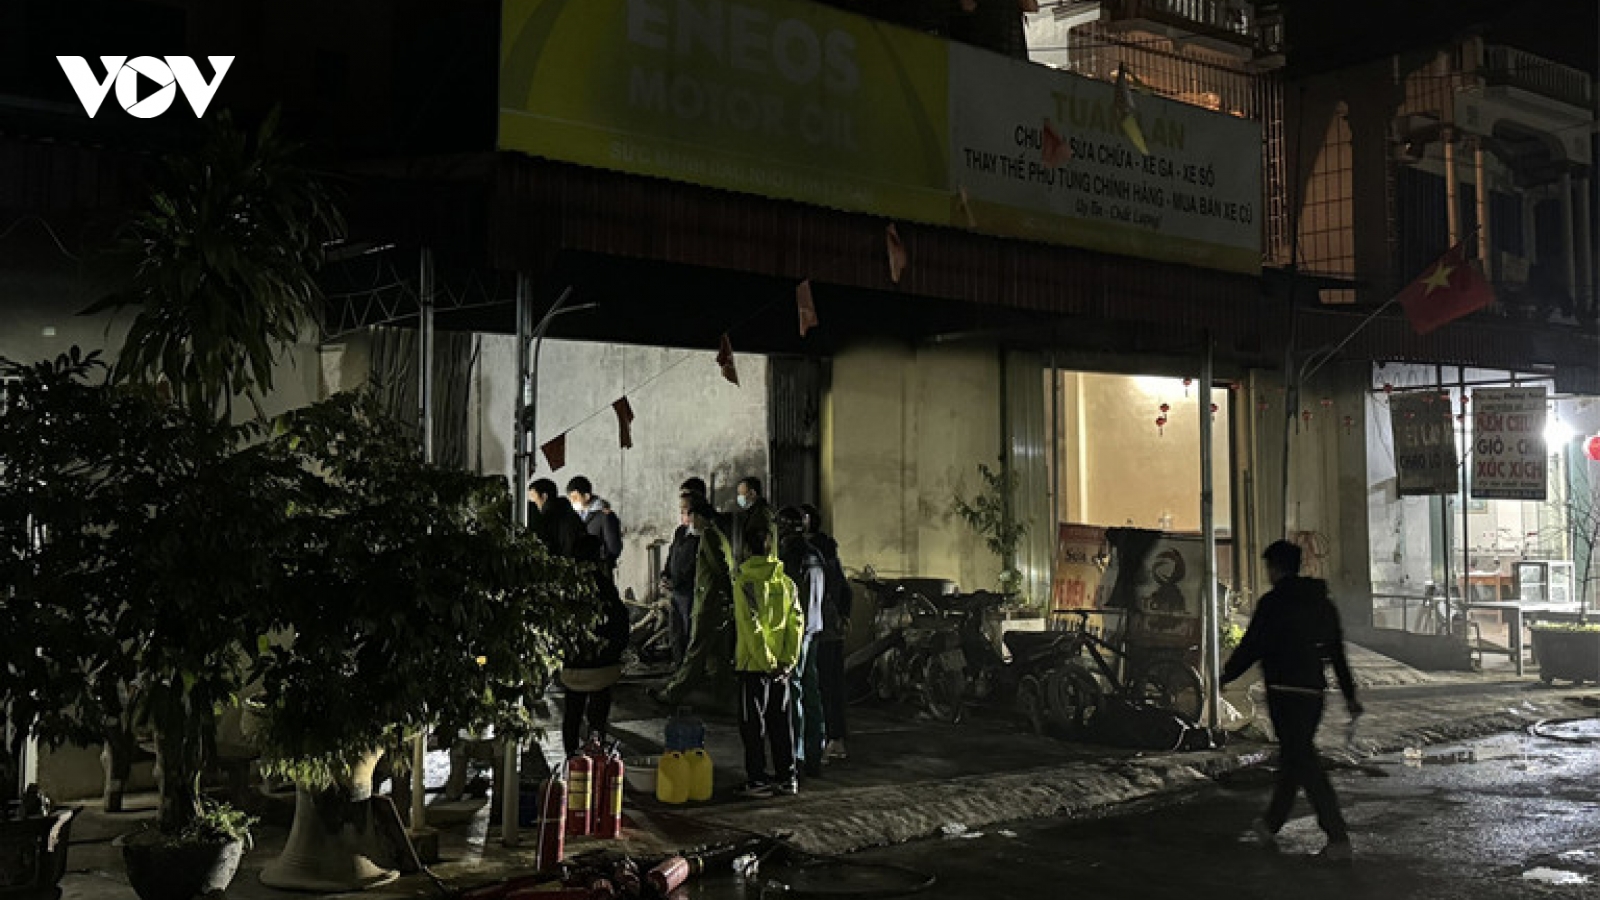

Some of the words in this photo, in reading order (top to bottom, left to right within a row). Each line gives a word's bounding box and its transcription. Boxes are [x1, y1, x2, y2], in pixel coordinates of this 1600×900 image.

[627, 0, 861, 95] ENEOS
[628, 66, 784, 136] MOTOR
[800, 103, 862, 153] OIL
[964, 148, 997, 172] THAY
[999, 152, 1026, 180] THẾ
[1029, 161, 1055, 191] PHỤ
[1093, 173, 1130, 200] CHÍNH
[1173, 190, 1197, 213] MUA
[1222, 200, 1237, 222] XE
[1141, 154, 1156, 175] XE
[1158, 157, 1173, 178] GA
[1183, 163, 1197, 185] XE
[1477, 435, 1504, 455] GIÒ
[1477, 458, 1505, 478] XÚC
